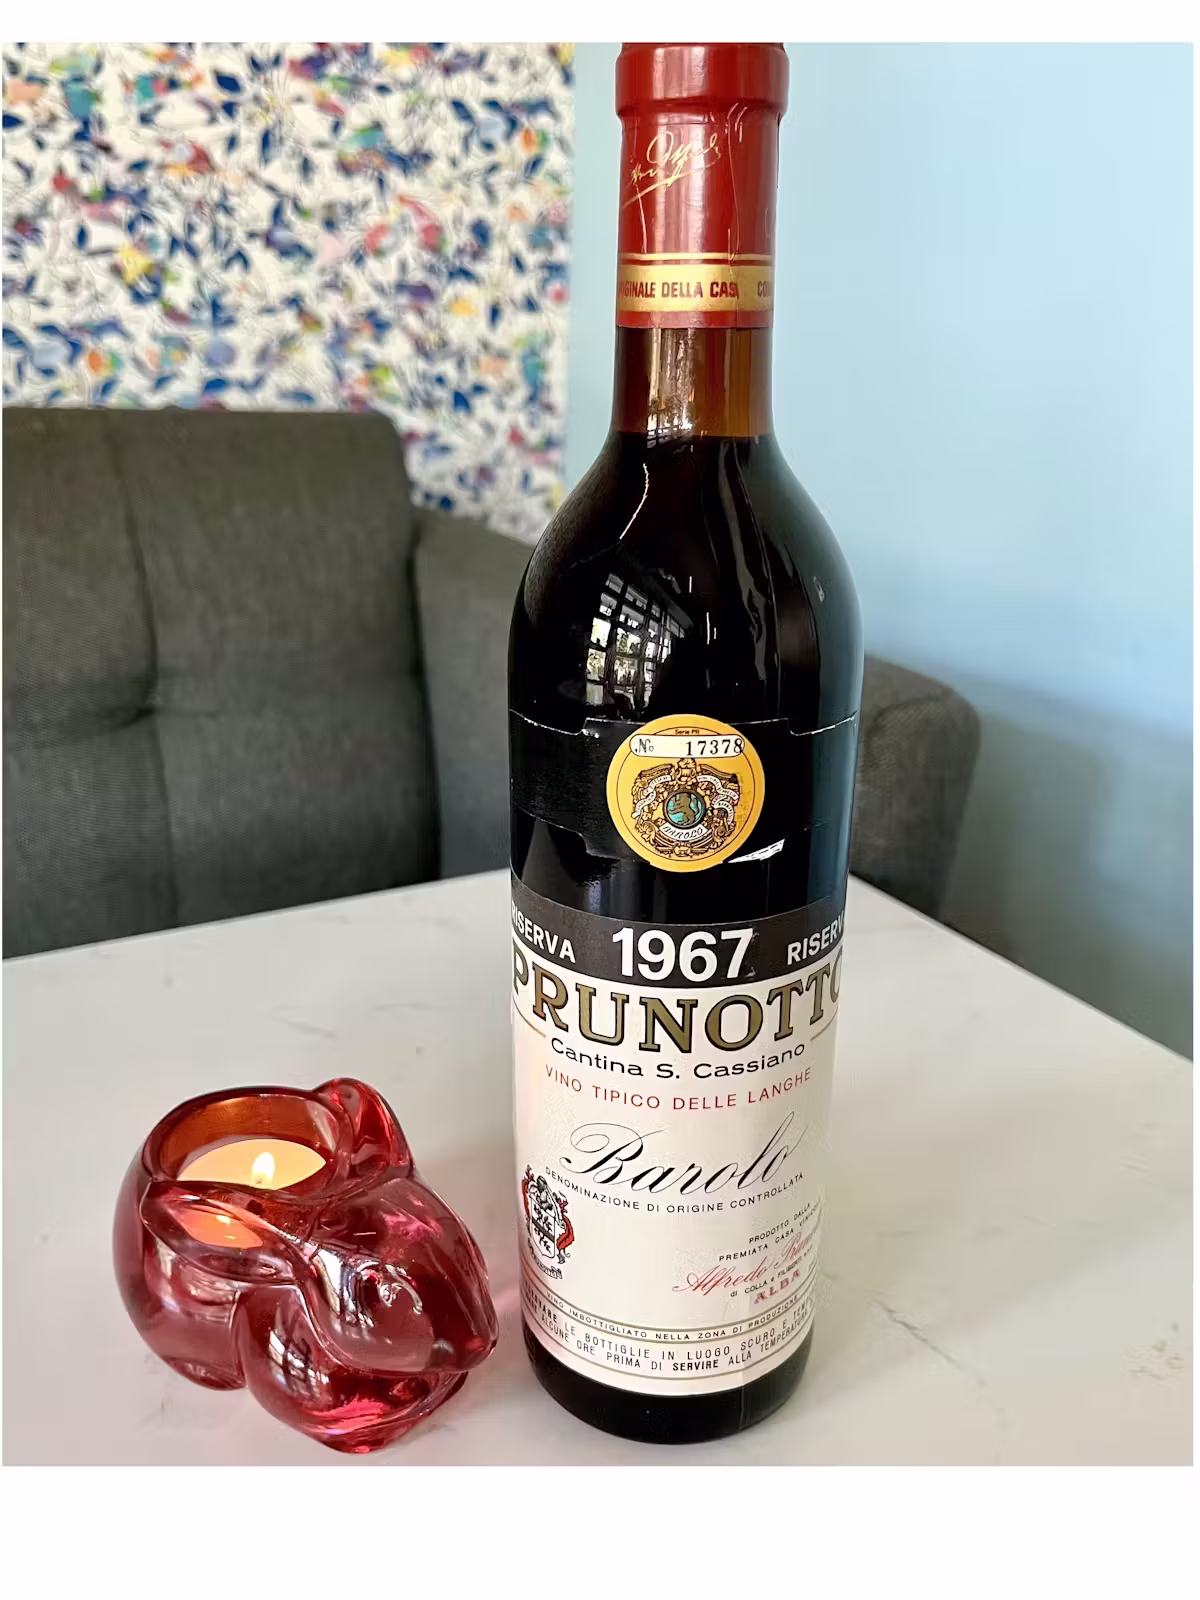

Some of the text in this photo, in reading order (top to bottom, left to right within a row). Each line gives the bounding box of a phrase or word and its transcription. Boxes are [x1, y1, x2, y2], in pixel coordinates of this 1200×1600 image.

[661, 281, 703, 298] DELLA
[686, 738, 743, 756] 17378
[512, 899, 844, 982] RISERVA 1967 RISERV
[551, 1037, 805, 1079] Cantina S. Cassiano
[545, 1063, 811, 1110] VINO TIPICO DELLE LANGHE
[559, 1111, 808, 1195] Barolo
[545, 1166, 803, 1213] DENOMINAZIONE DI ORIGINE CONTROLLATA
[719, 1243, 769, 1262] PREMIATA
[775, 1227, 794, 1244] CASA
[748, 1202, 810, 1245] PRODOTTO DALLA
[672, 1256, 774, 1297] Alfredo
[730, 1290, 738, 1298] di
[744, 1281, 768, 1295] COLLA
[754, 1269, 801, 1304] ALBA
[569, 1307, 647, 1338] IMBOTTIGLIATO
[698, 1330, 726, 1339] ZONA
[748, 1295, 798, 1329] PRODUZIONE
[541, 1313, 570, 1343] ALCUNE
[576, 1339, 595, 1356] ORE
[606, 1352, 641, 1368] PRIMA
[651, 1361, 662, 1371] DI
[672, 1359, 719, 1371] SERVIRE
[728, 1350, 752, 1366] ALLA
[565, 1321, 576, 1336] LE
[585, 1333, 650, 1358] BOTTIGLIE
[662, 1351, 675, 1360] IN
[687, 1346, 730, 1360] LUOGO
[740, 1327, 775, 1351] SCURO
[782, 1319, 787, 1329] E
